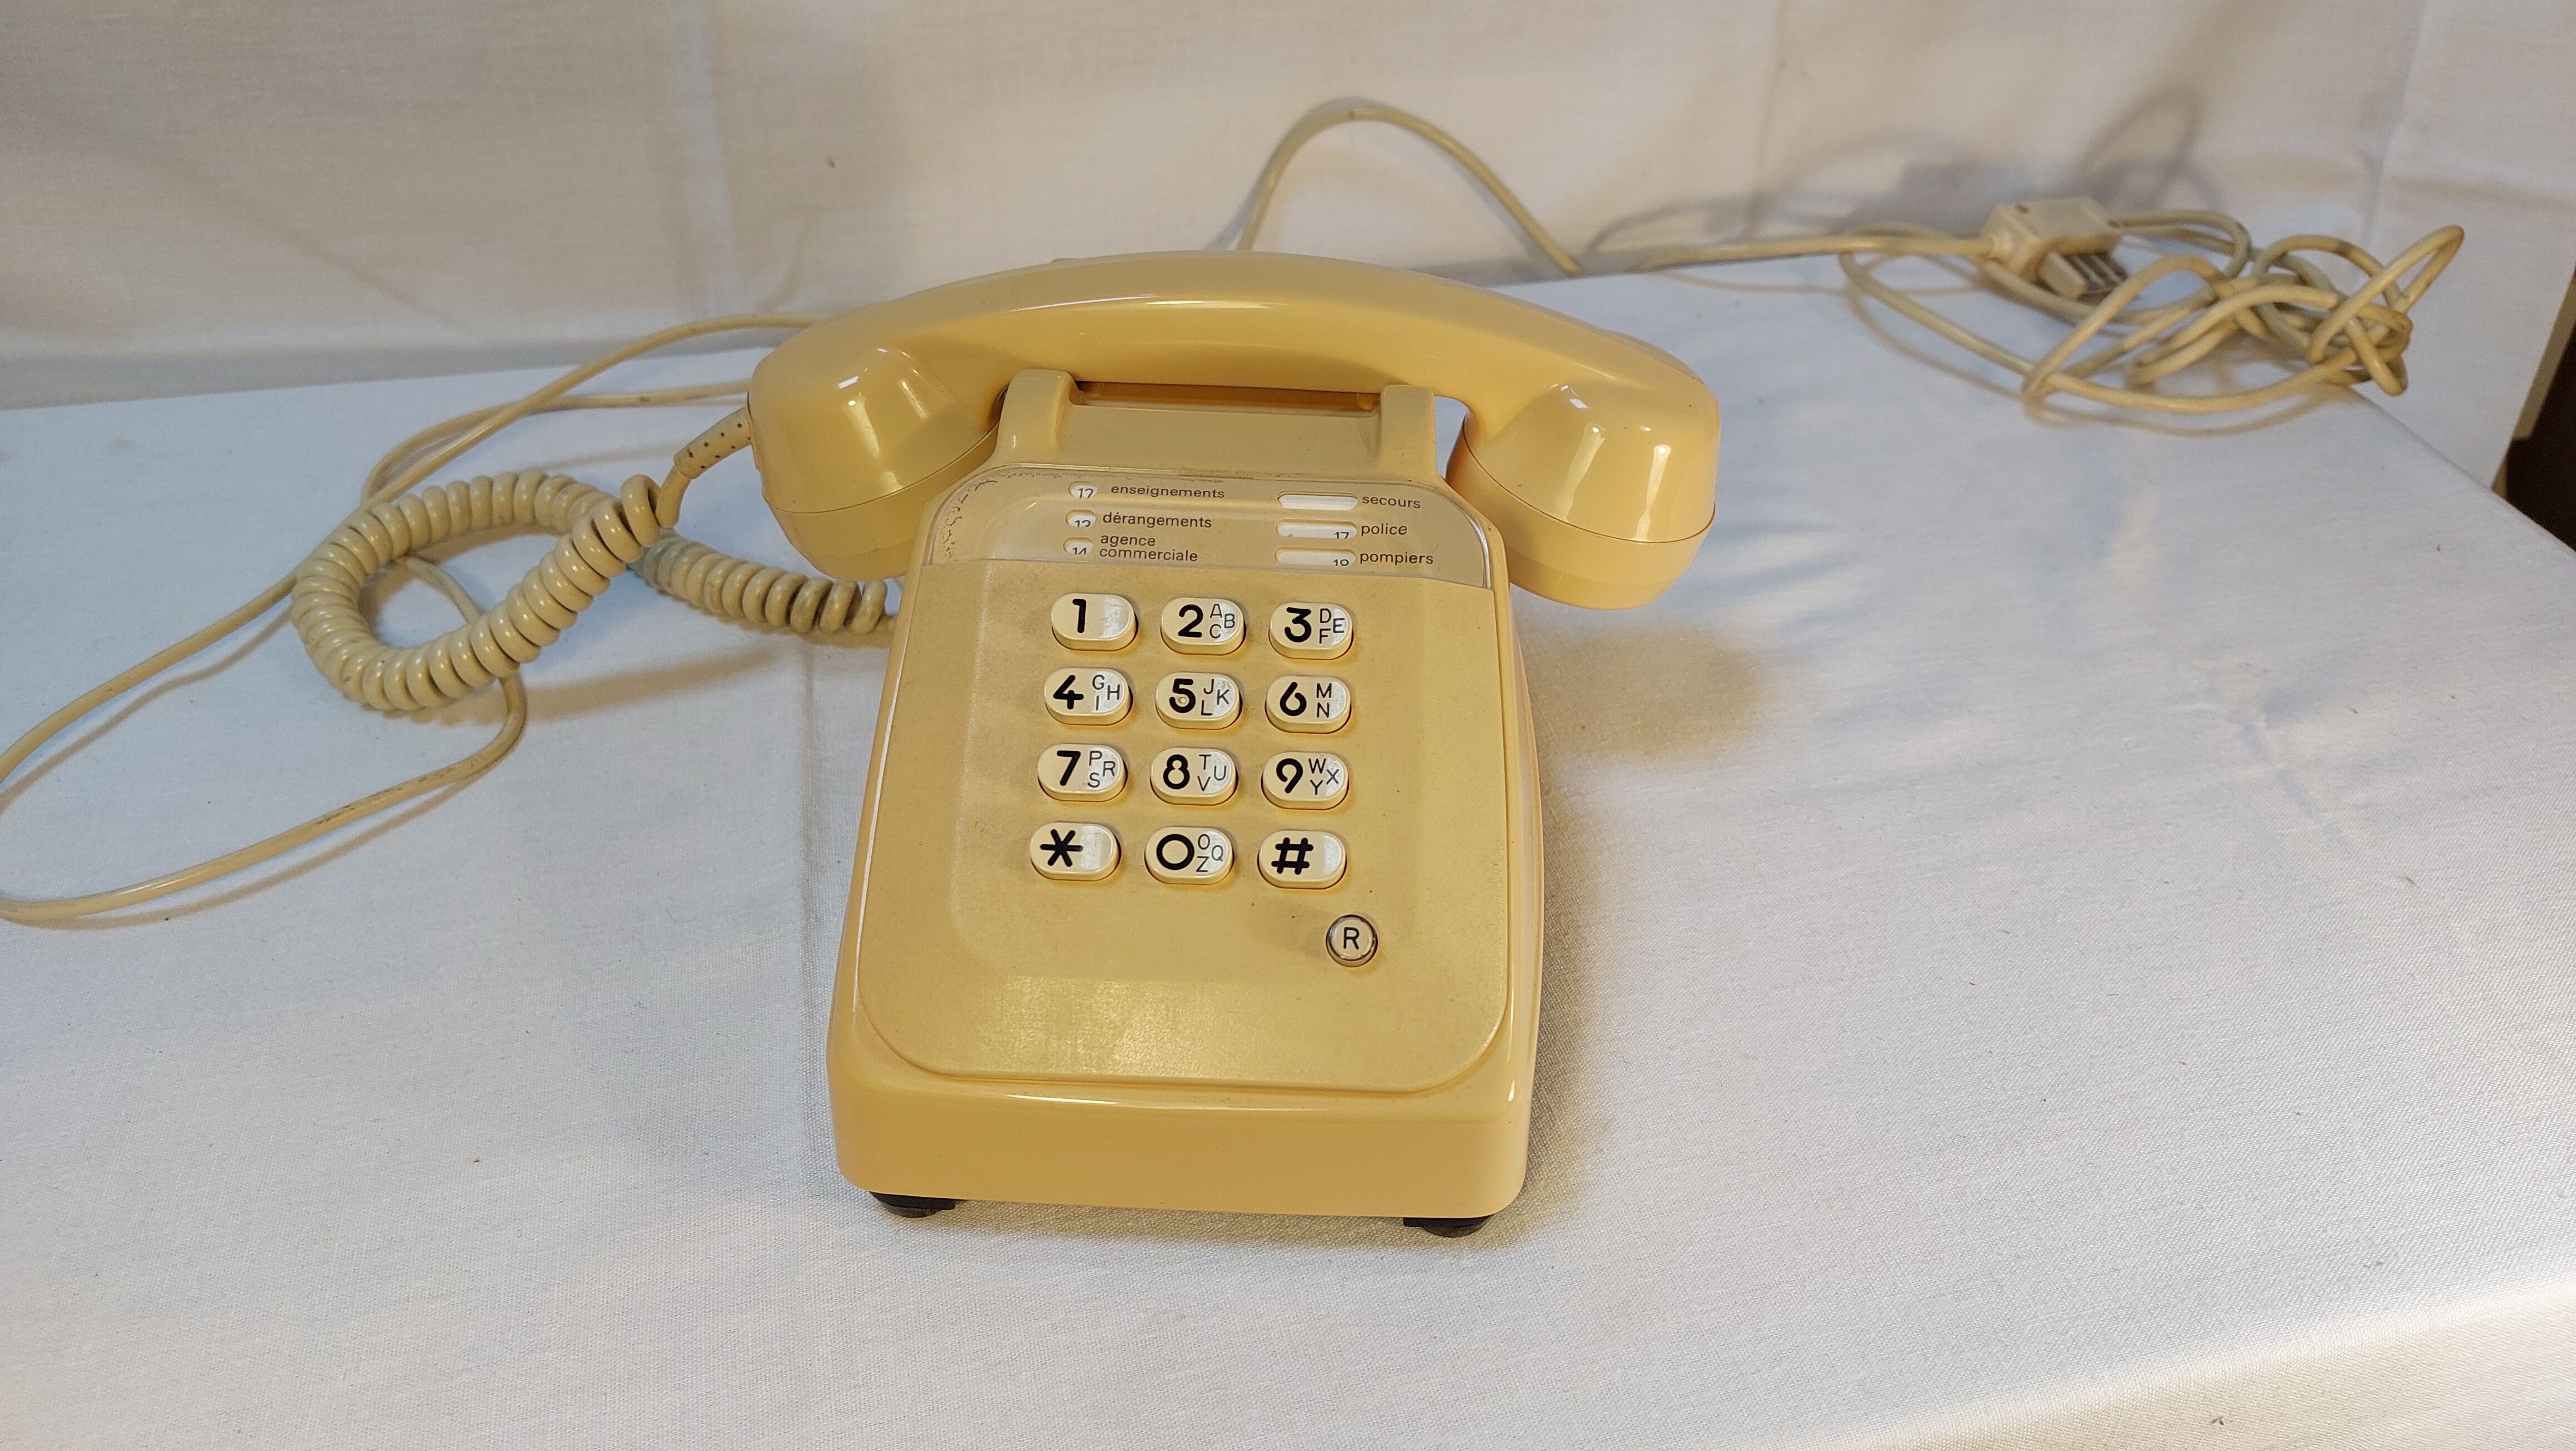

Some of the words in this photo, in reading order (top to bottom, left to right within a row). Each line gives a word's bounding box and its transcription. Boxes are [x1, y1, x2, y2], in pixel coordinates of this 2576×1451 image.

[1111, 485, 1224, 498] enseignements
[1362, 496, 1421, 508] secours
[1102, 512, 1212, 528] dérangements
[1361, 523, 1407, 537] police
[1099, 548, 1198, 562] commerciale
[1100, 535, 1156, 547] agence
[1360, 551, 1433, 566] pompiers
[1072, 598, 1087, 634] 1
[1177, 604, 1204, 638] 2
[1284, 607, 1312, 643] 3
[1052, 674, 1085, 710] 4
[1169, 678, 1196, 714] 5
[1279, 681, 1307, 717] 6
[1056, 750, 1081, 786] 7
[1163, 754, 1191, 790] 8
[1276, 758, 1304, 794] 9
[1343, 927, 1360, 950] R
